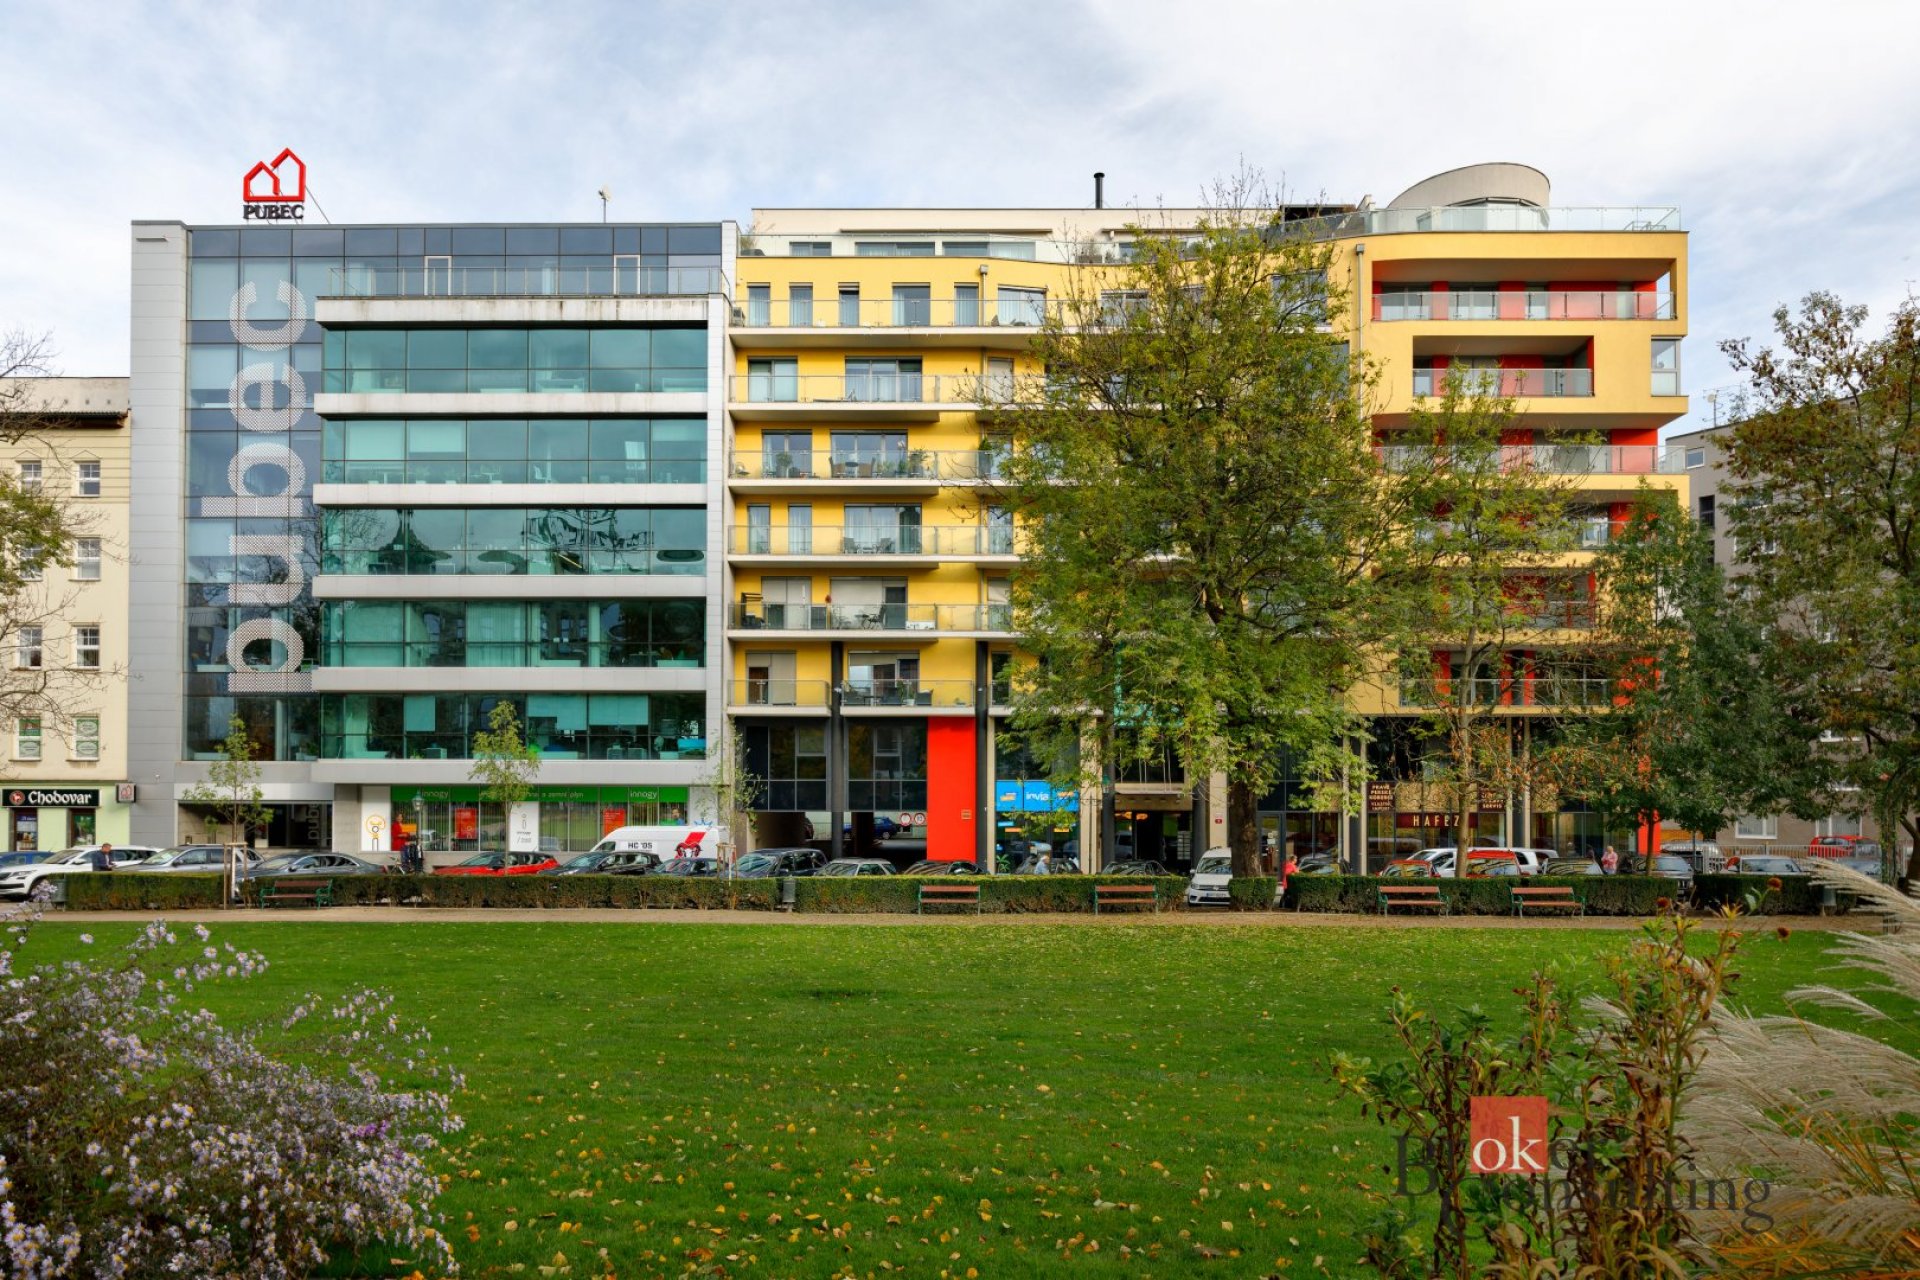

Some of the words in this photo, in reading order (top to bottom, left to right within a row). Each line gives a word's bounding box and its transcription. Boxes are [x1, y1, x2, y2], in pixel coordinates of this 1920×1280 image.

[242, 204, 305, 220] PUBEC
[202, 279, 316, 693] pubec
[28, 790, 92, 805] Chodovar
[630, 790, 658, 800] innogy
[1025, 791, 1049, 801] invia
[1413, 815, 1460, 827] HAFEZ
[627, 842, 639, 850] HC
